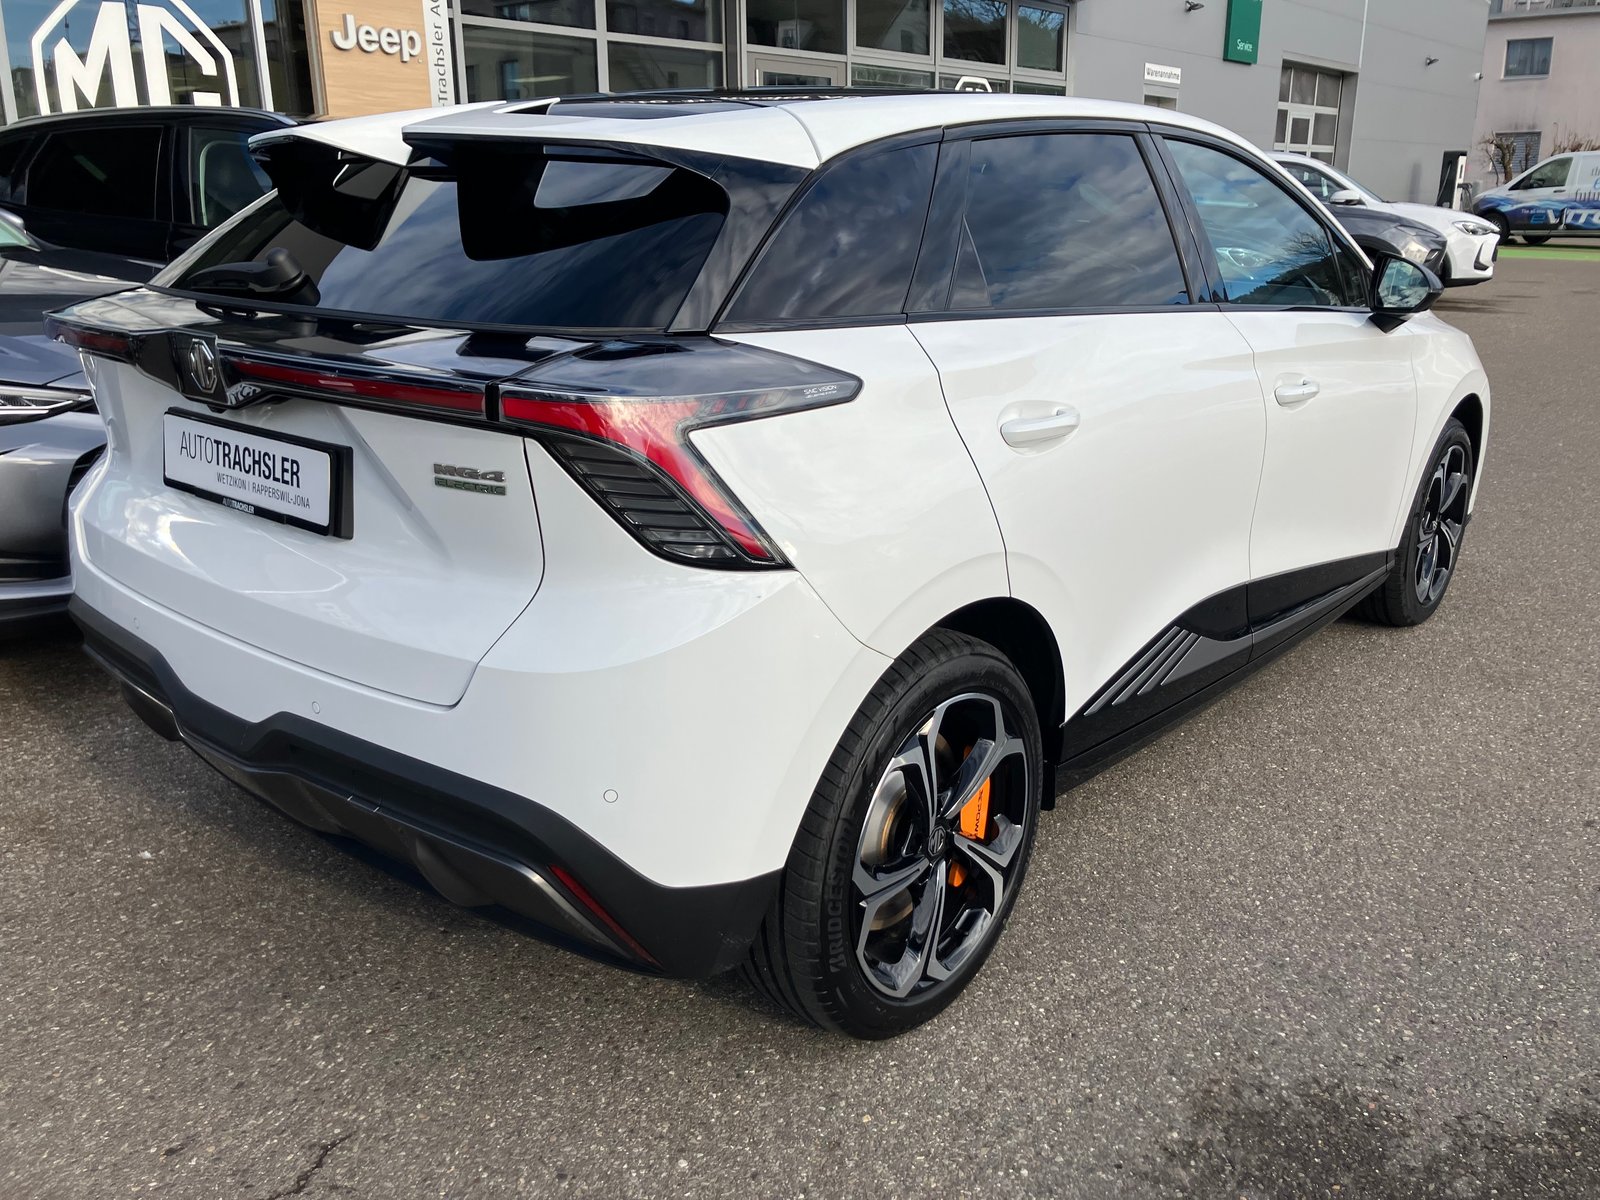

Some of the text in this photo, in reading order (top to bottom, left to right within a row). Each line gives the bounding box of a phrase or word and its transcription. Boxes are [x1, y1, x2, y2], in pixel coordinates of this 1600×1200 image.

[430, 0, 441, 17] A
[329, 13, 422, 63] Jeep
[1236, 38, 1253, 52] Service
[1145, 67, 1180, 81] Warenannahme
[180, 431, 301, 489] AUTOTRACHSLER
[433, 463, 505, 483] MG4
[216, 472, 247, 491] WETZIKON
[252, 482, 311, 509] RAPPERSWIL-JONA
